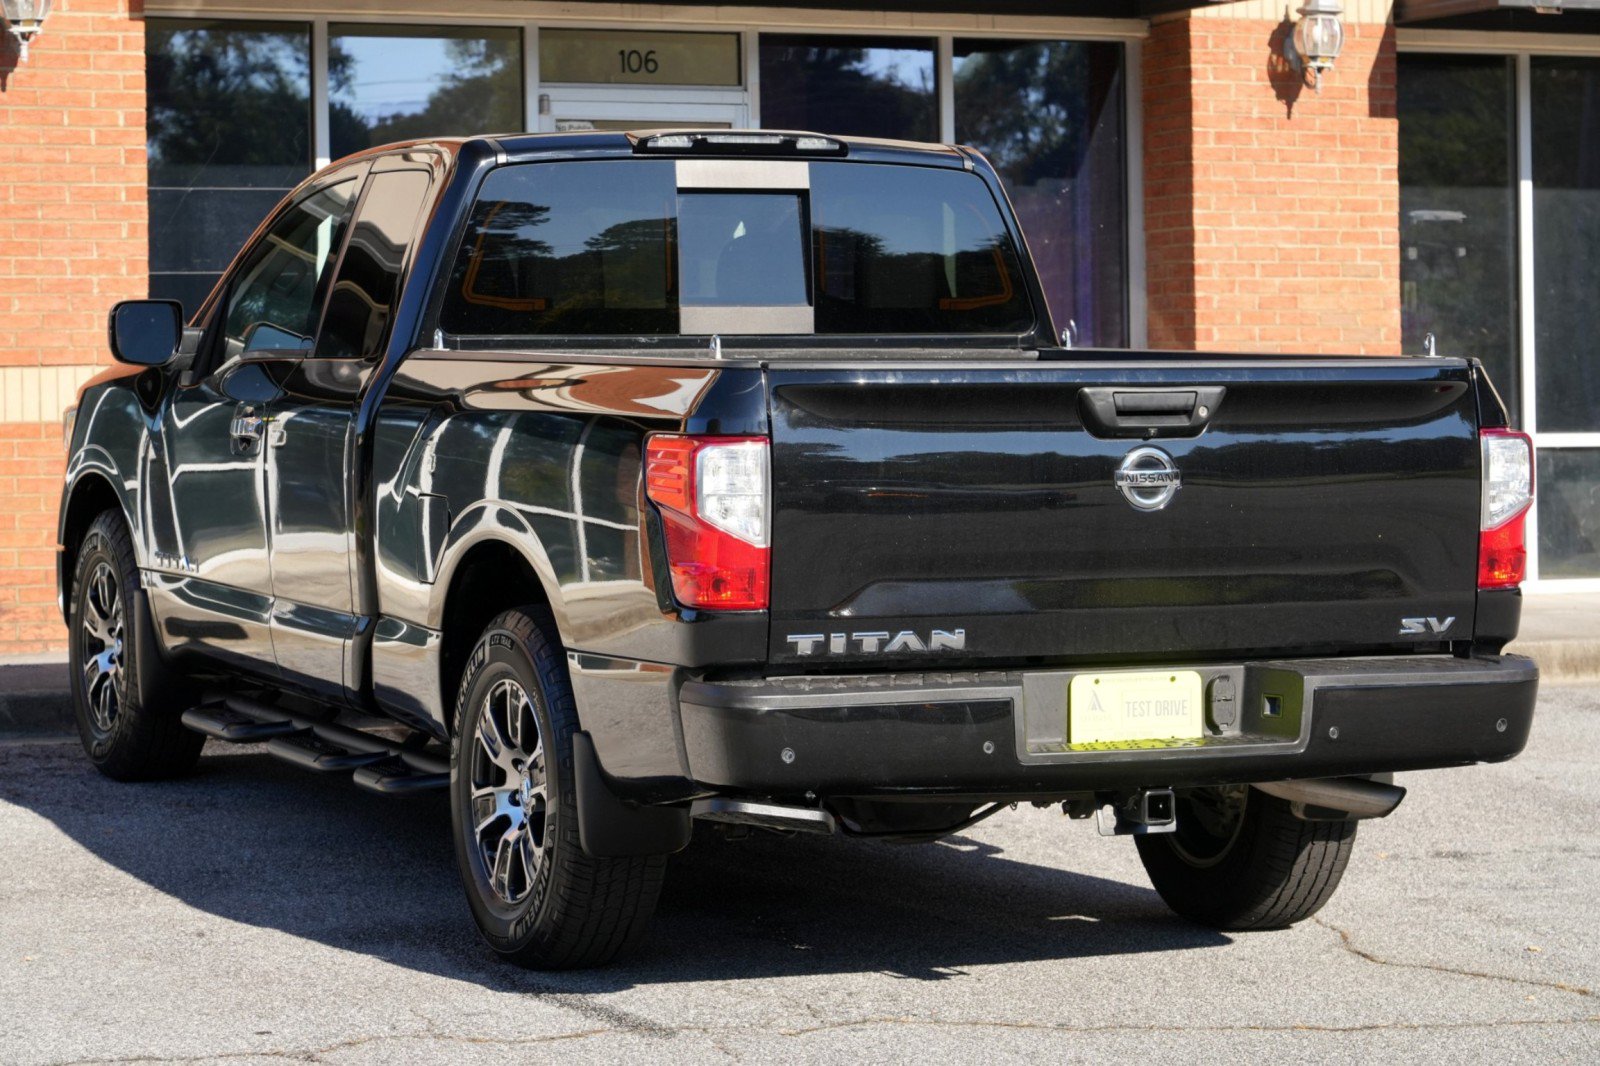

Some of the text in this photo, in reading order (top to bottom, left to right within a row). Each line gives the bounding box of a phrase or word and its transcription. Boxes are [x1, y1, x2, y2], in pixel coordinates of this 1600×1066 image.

[618, 50, 659, 74] 106
[1125, 473, 1174, 483] NISSAN
[1399, 616, 1456, 634] SV
[787, 629, 966, 655] TITAN
[1125, 700, 1151, 718] TEST
[1154, 699, 1188, 717] DRIVE
